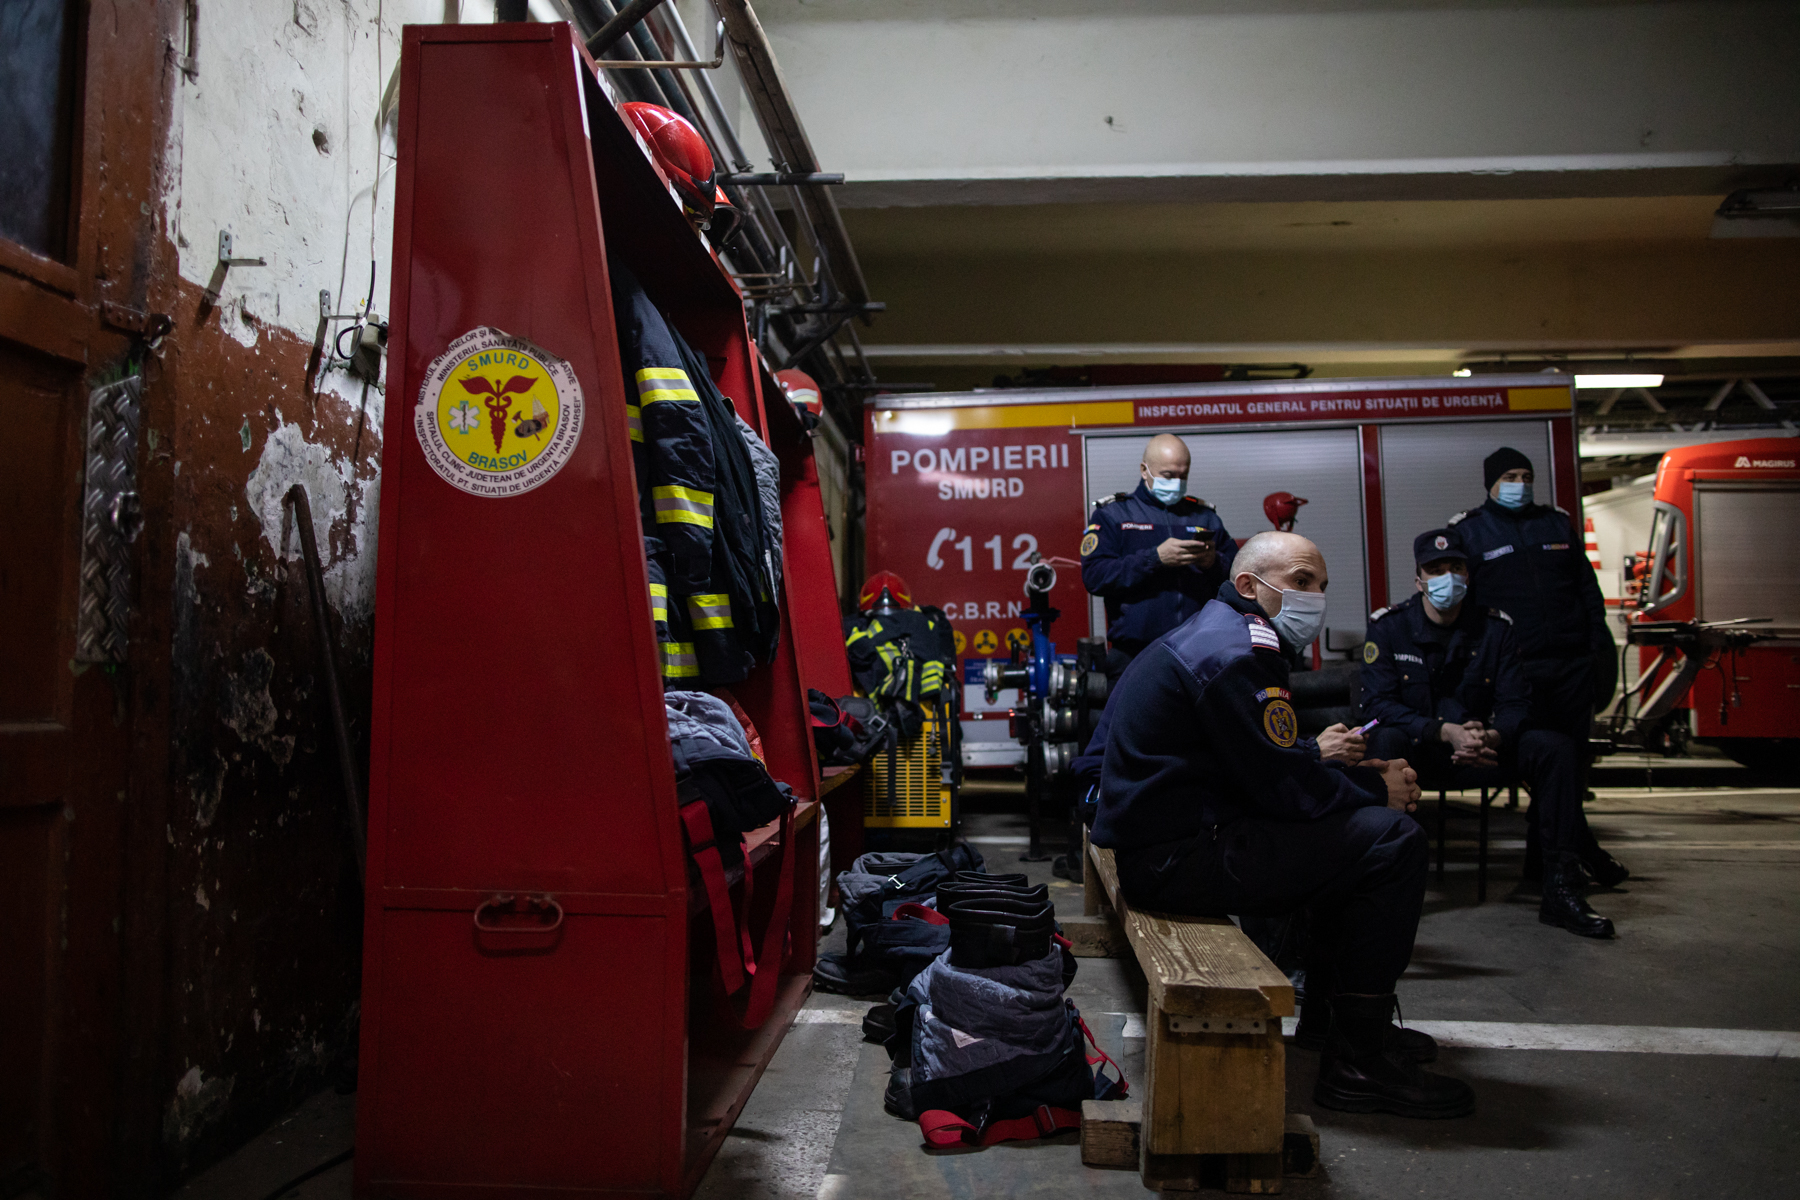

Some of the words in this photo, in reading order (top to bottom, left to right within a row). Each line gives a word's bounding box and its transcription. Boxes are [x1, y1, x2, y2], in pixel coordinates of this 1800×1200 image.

[437, 344, 480, 382] MINISTERUL
[529, 347, 559, 376] PUBLICE
[468, 352, 529, 371] SMURD
[1139, 403, 1243, 417] INSPECTORATUL
[1247, 401, 1306, 414] GENERAL
[1310, 398, 1361, 412] PENTRU
[1422, 396, 1439, 408] DE
[416, 419, 456, 482] INSPECTORATUL
[457, 478, 469, 488] PT.
[510, 484, 521, 492] DE
[427, 411, 443, 452] SPITALUL
[442, 451, 466, 473] CLINIC
[466, 470, 512, 483] JUDETEAN
[514, 470, 526, 480] DE
[527, 442, 560, 474] URGENTA
[556, 404, 570, 441] BRASOV
[468, 450, 526, 470] BRASOV
[891, 444, 1069, 474] POMPIERII
[1752, 460, 1796, 468] MAGIRUS
[938, 477, 1024, 500] SMURD
[955, 533, 1038, 571] 112
